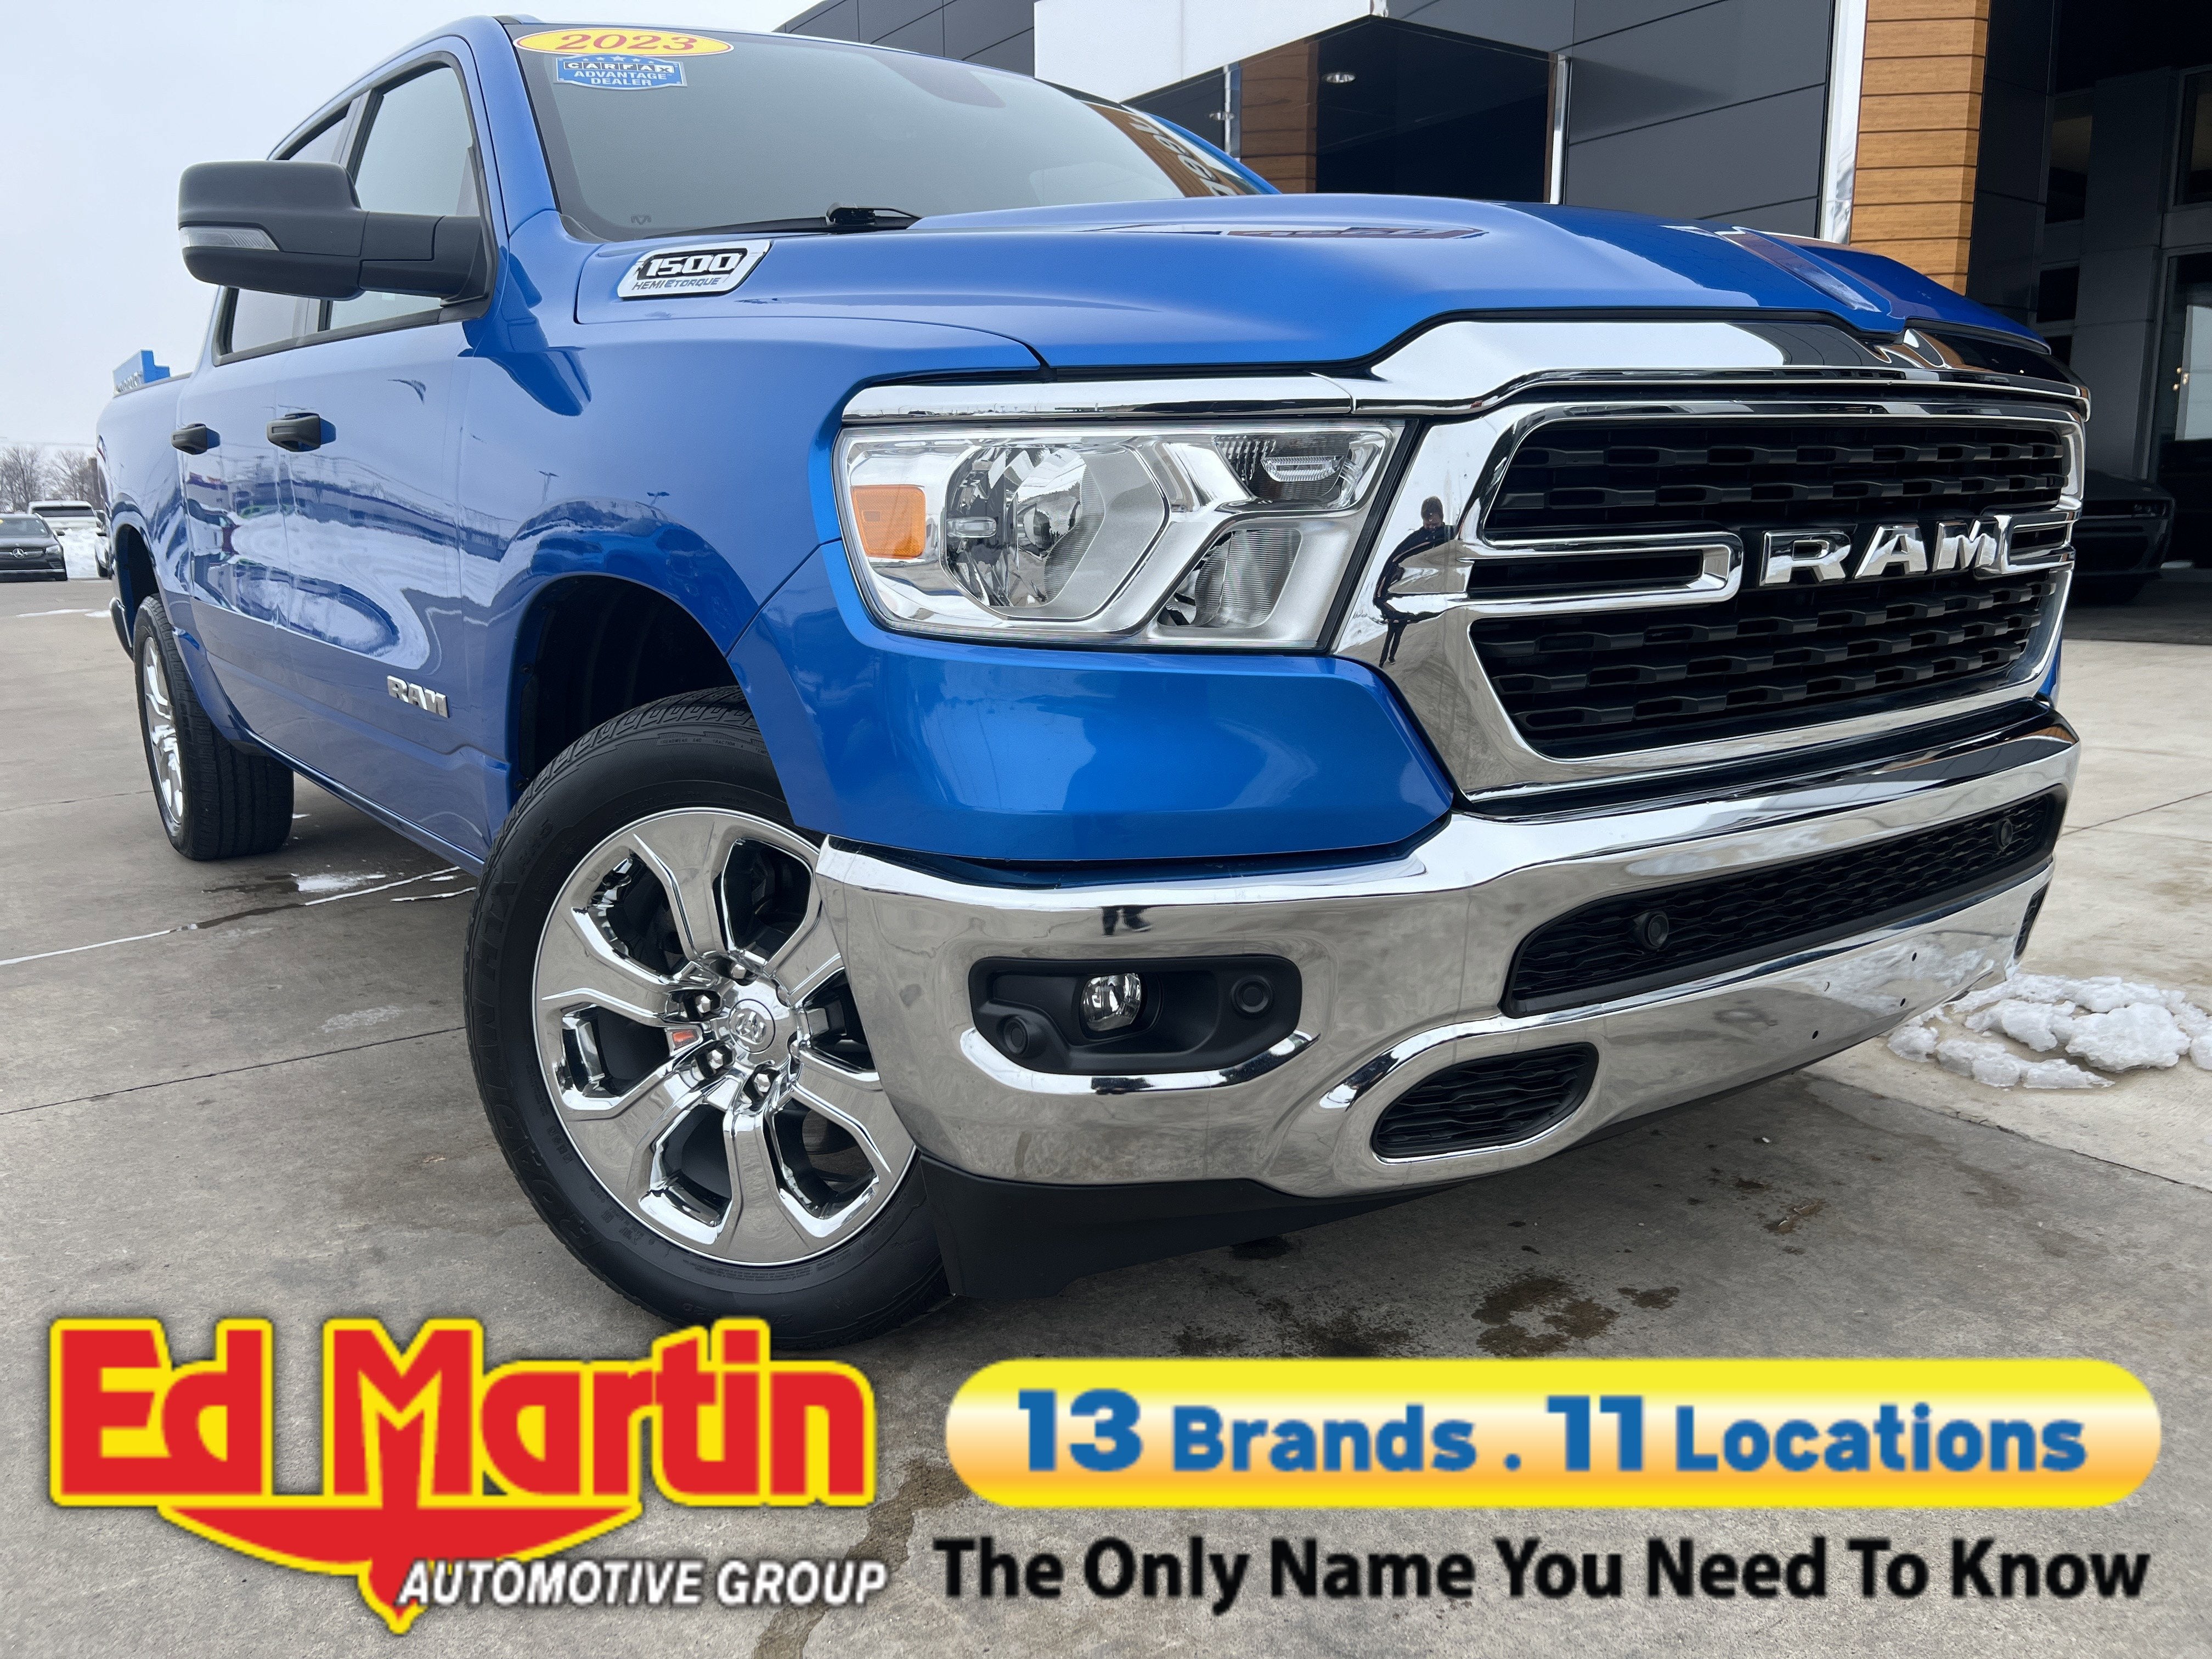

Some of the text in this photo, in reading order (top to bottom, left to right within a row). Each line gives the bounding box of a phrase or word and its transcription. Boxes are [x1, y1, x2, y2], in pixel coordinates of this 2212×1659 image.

[554, 34, 698, 50] 2023
[567, 62, 674, 73] CARFAX
[574, 70, 668, 80] ADVANTAGE
[590, 77, 652, 86] DEALER
[646, 252, 743, 276] 1500
[1759, 518, 2000, 586] RAM
[387, 675, 450, 719] RAM
